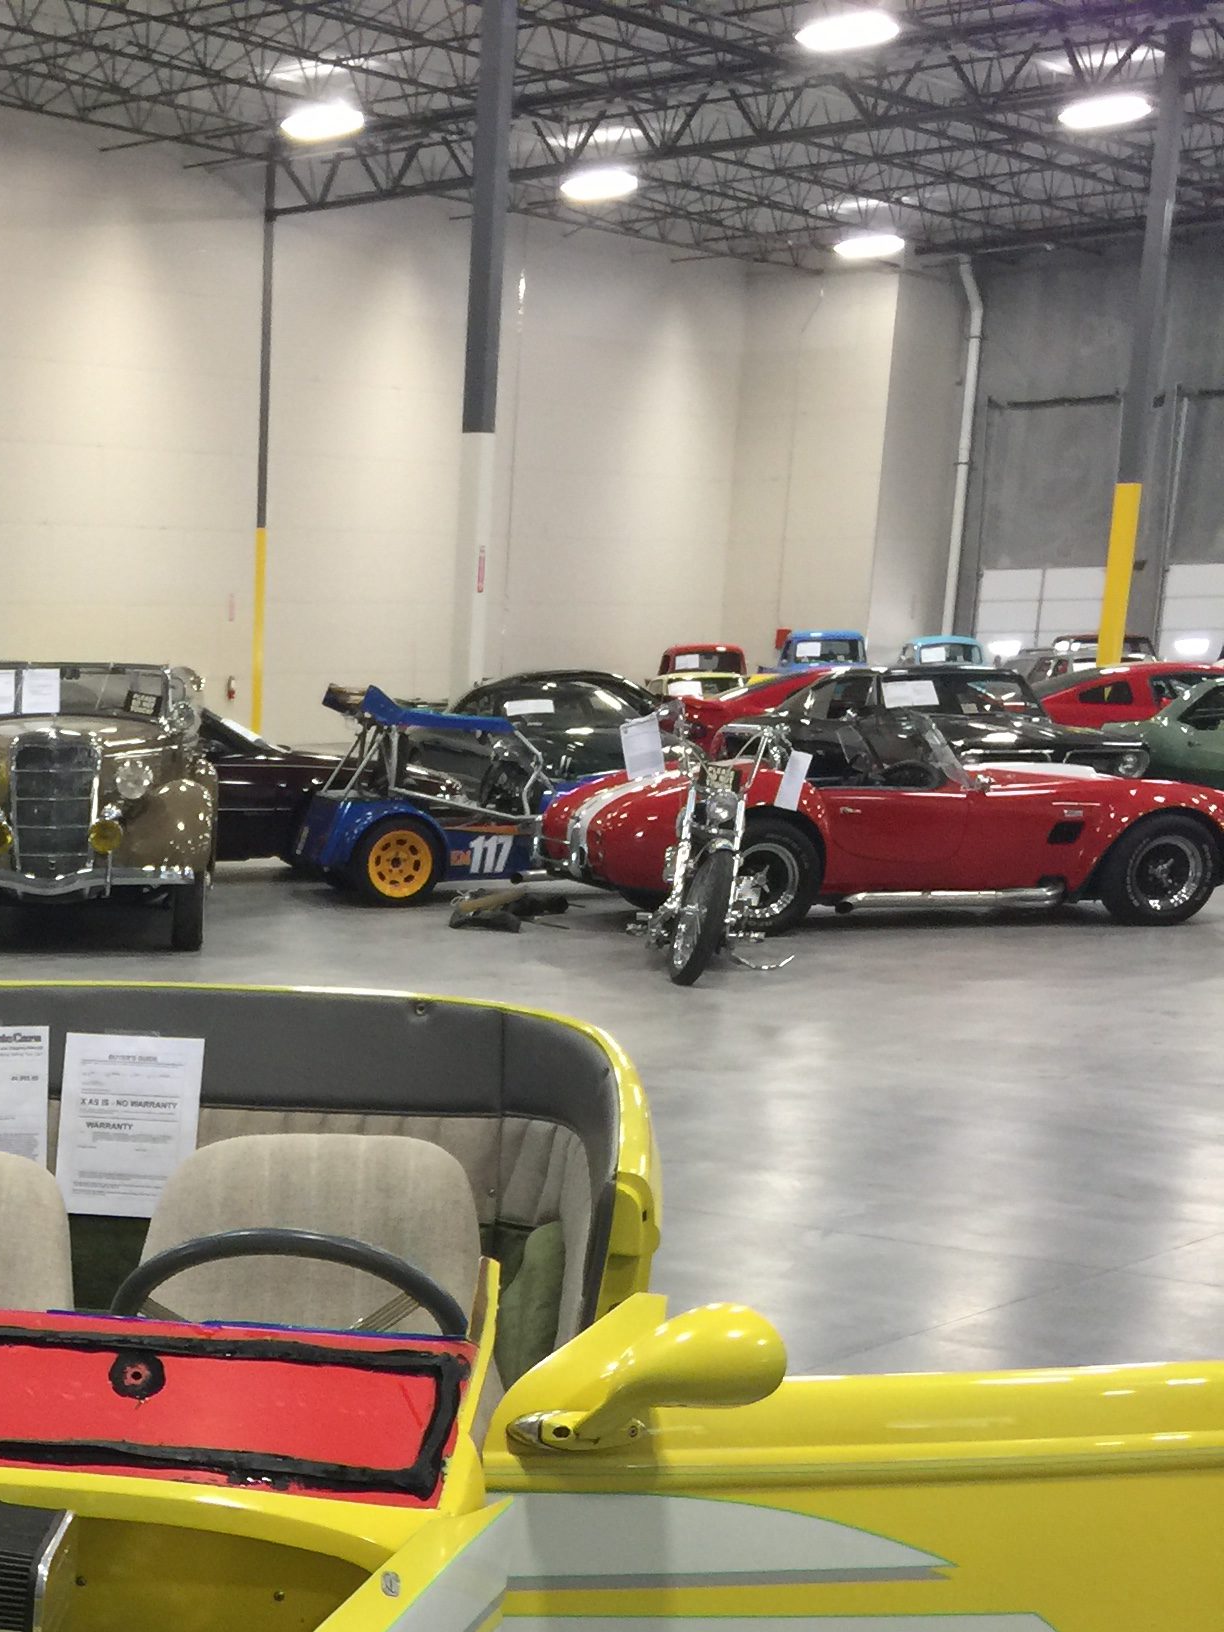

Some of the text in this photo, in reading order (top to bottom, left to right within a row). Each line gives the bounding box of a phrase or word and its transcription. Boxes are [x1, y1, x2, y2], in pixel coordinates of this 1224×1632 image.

[469, 834, 514, 874] 117
[130, 1101, 178, 1109] WARRANTY
[86, 1122, 133, 1130] WARRANTY
